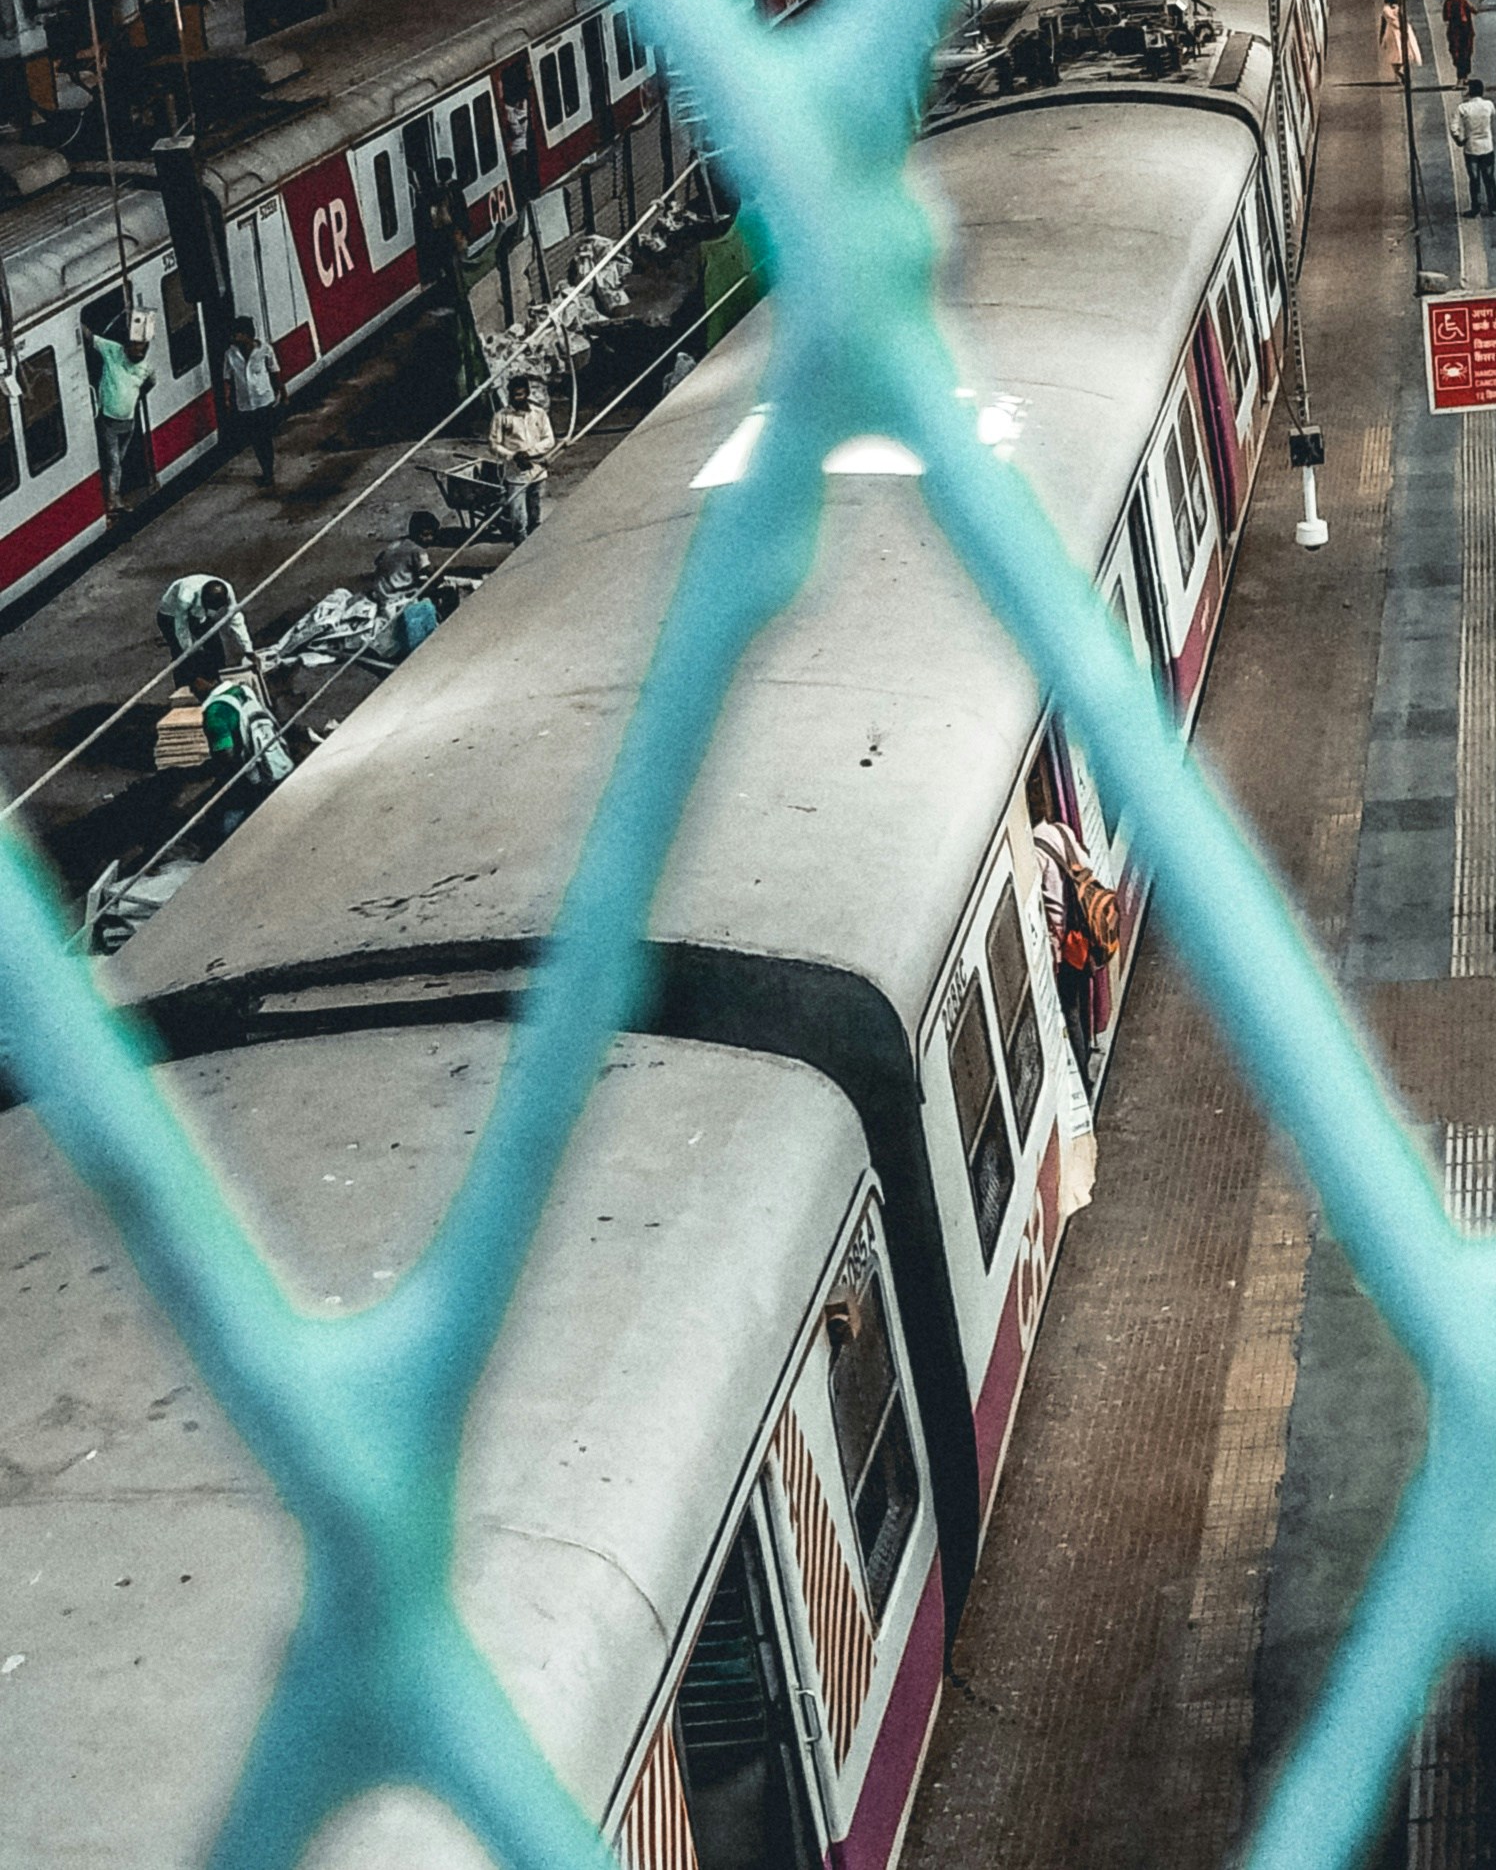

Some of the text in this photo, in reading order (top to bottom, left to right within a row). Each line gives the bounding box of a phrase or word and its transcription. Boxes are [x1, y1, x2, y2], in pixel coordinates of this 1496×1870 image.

[313, 198, 355, 288] CR
[488, 183, 508, 227] CR
[1017, 1186, 1046, 1353] CR
